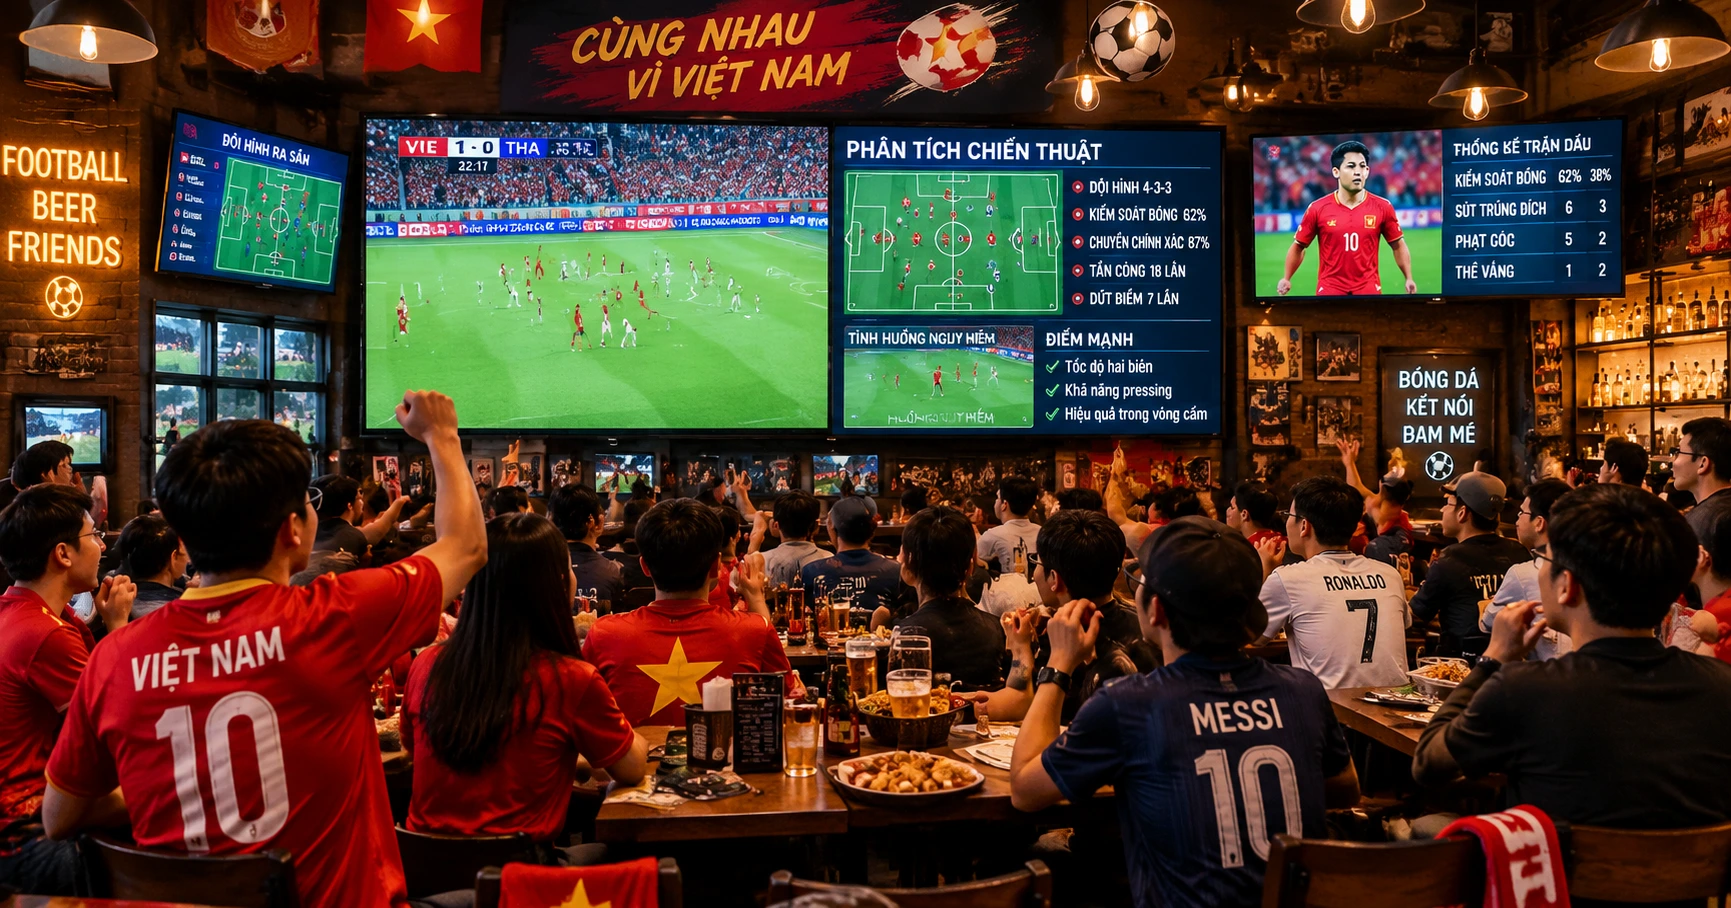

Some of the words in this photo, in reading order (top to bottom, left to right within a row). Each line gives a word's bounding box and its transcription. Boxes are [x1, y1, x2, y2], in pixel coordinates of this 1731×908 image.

[571, 16, 685, 64] CÙNG
[697, 10, 816, 52] NHAU
[673, 55, 754, 101] VIỆT
[759, 51, 851, 92] NAM
[272, 145, 287, 161] RA
[405, 140, 438, 154] VIE
[455, 140, 465, 154] 1
[482, 140, 494, 154] 0
[505, 141, 541, 155] THA
[847, 136, 906, 159] PHÂN
[912, 136, 961, 160] TÍCH
[1036, 139, 1103, 165] THUẬT
[3, 145, 128, 182] FOOTBALL
[458, 160, 488, 171] 22:17
[1558, 169, 1582, 183] 62%
[1589, 168, 1612, 182] 38%
[1142, 181, 1172, 194] 4-3-3
[33, 190, 97, 223] BEER
[1479, 199, 1517, 217] TRÚNG
[1565, 200, 1573, 214] 6
[1599, 199, 1607, 213] 3
[8, 230, 120, 267] FRIENDS
[1131, 233, 1161, 249] CHÍNH
[1188, 236, 1210, 249] 87%
[1343, 232, 1359, 251] 10
[1455, 233, 1487, 251] PHẠT
[1565, 232, 1573, 246] 5
[1598, 231, 1607, 245] 2
[1149, 265, 1161, 278] 18
[1565, 263, 1572, 277] 1
[1598, 262, 1607, 277] 2
[1147, 292, 1154, 305] 7
[1107, 359, 1125, 374] hai
[1399, 366, 1449, 389] BÓNG
[1455, 367, 1480, 389] DÁ
[1123, 383, 1172, 400] pressing
[1119, 408, 1149, 424] trong
[1403, 425, 1443, 444] BAM
[1450, 421, 1476, 444] MÉ
[1323, 574, 1386, 591] RONALDO
[1345, 598, 1378, 664] 7
[131, 642, 201, 692] VIỆT
[210, 626, 286, 678] NAM
[1189, 697, 1283, 736] MESSI
[155, 690, 289, 851] 10
[1194, 744, 1303, 869] 10
